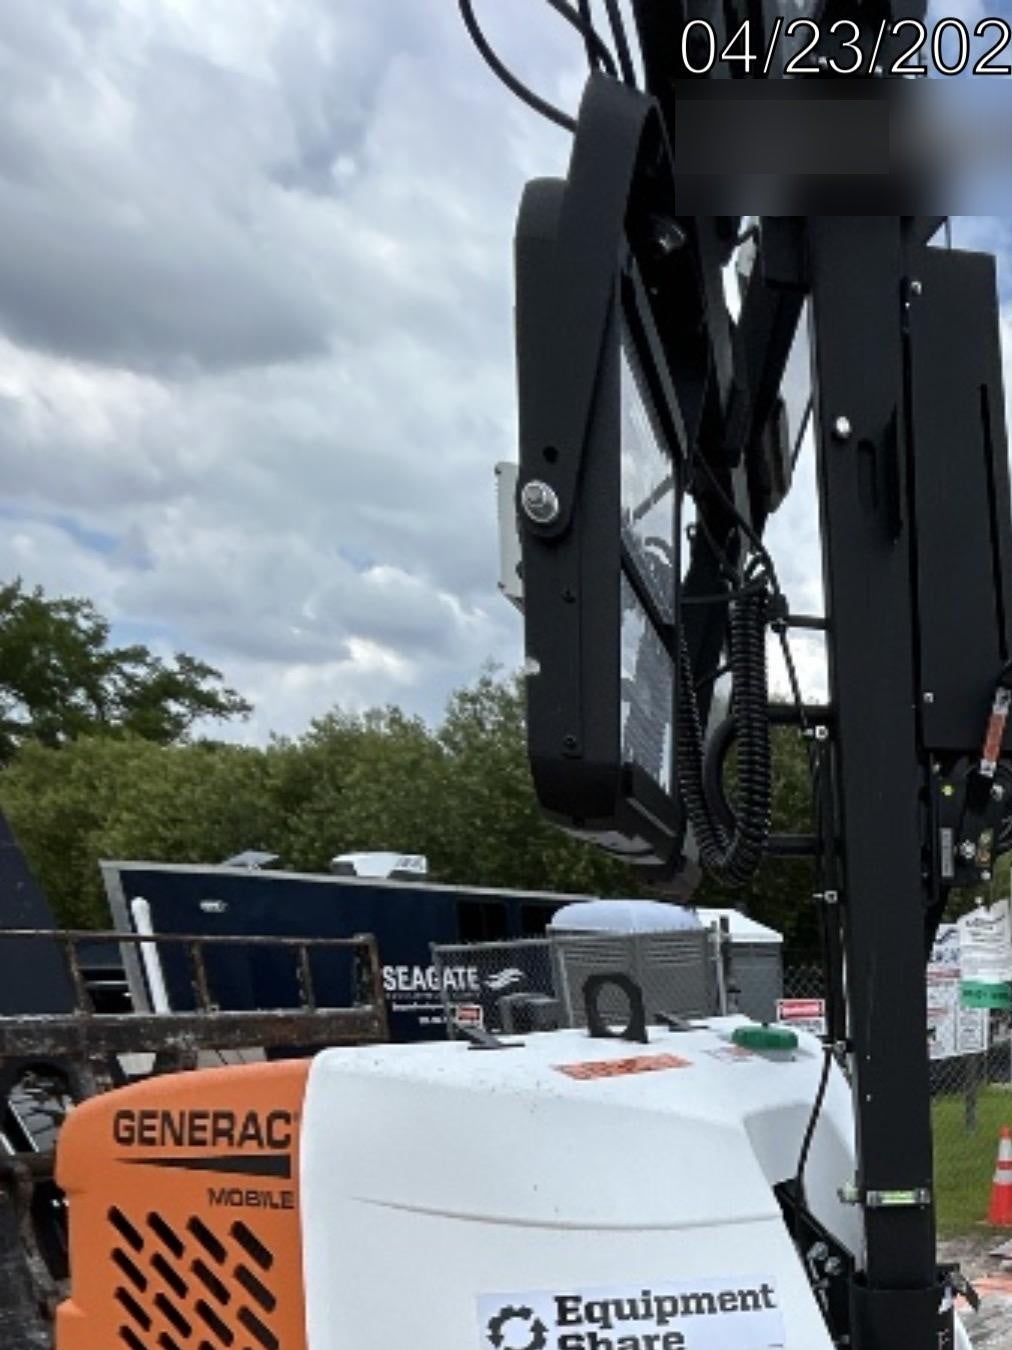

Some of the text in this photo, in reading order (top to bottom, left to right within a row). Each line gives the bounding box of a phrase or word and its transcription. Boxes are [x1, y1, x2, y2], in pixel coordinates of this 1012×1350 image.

[383, 965, 481, 991] SEAGATE
[113, 1109, 292, 1149] GENERAC
[207, 1188, 295, 1209] MOBILE
[554, 1283, 778, 1329] Equipment
